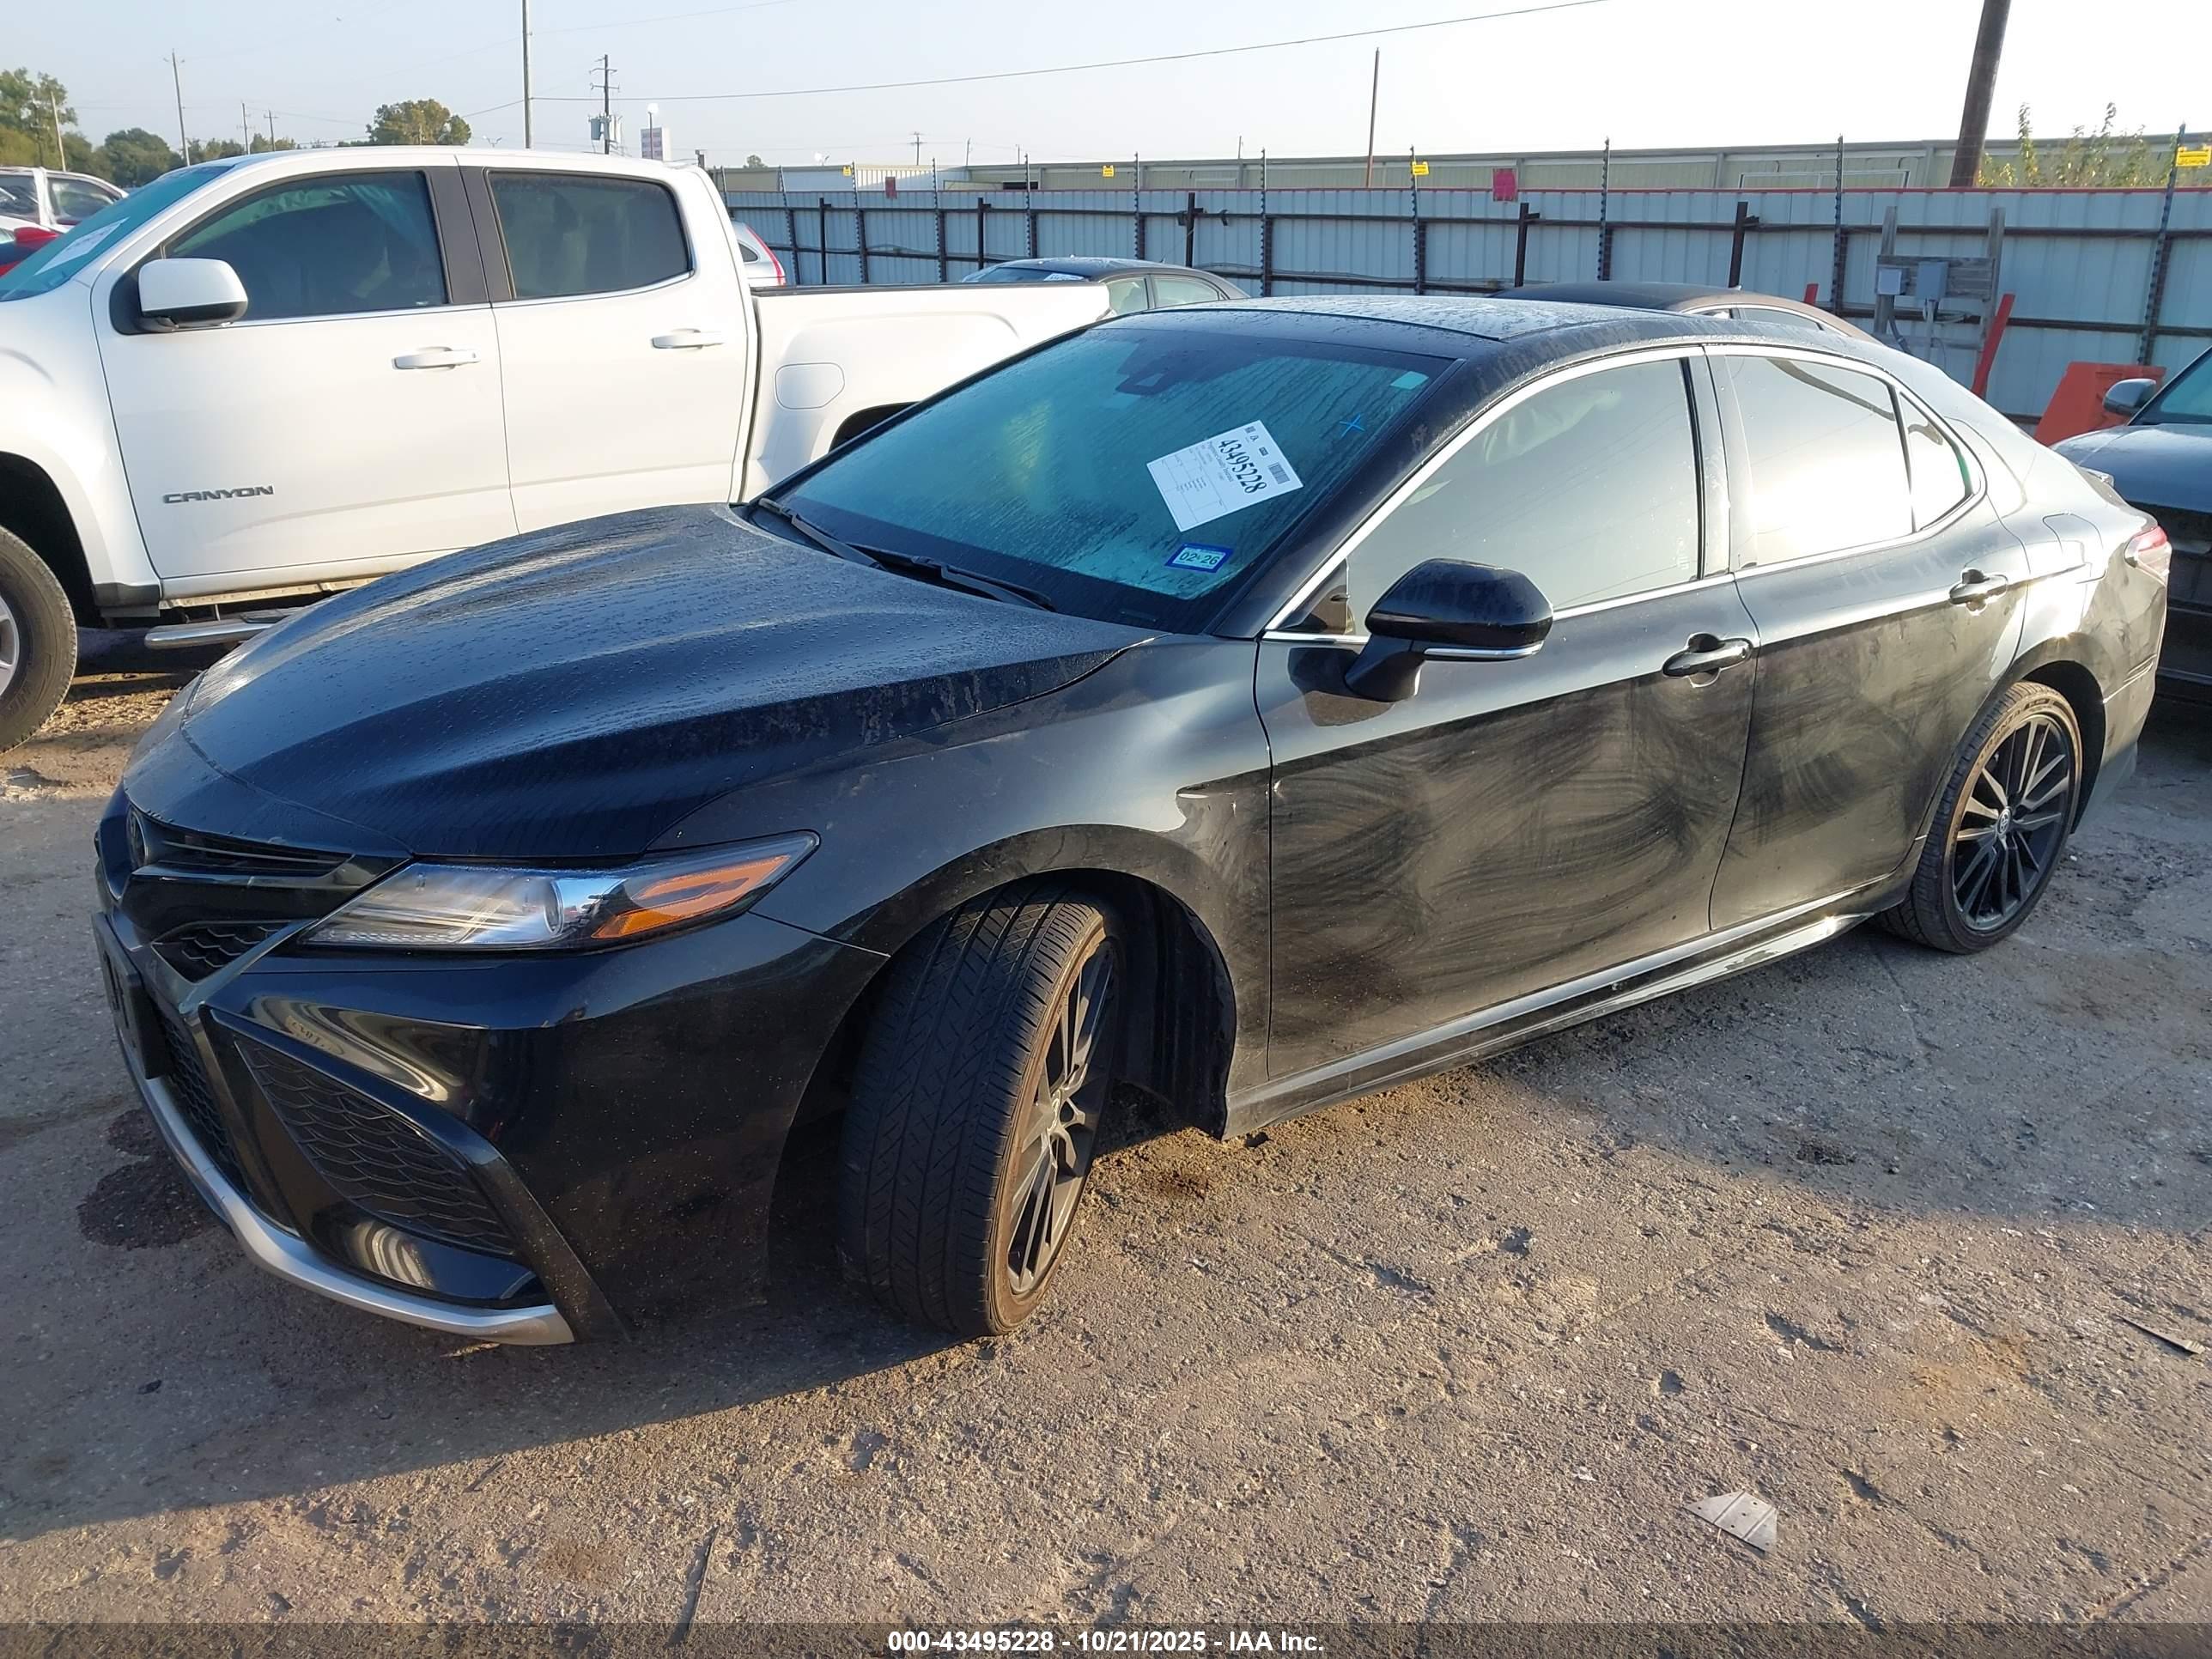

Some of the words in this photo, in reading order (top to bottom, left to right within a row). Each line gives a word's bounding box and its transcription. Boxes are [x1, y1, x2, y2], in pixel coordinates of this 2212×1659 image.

[1218, 440, 1267, 495] 43495228
[163, 485, 274, 504] CANYON
[1180, 552, 1197, 562] 02
[1201, 555, 1220, 565] 26
